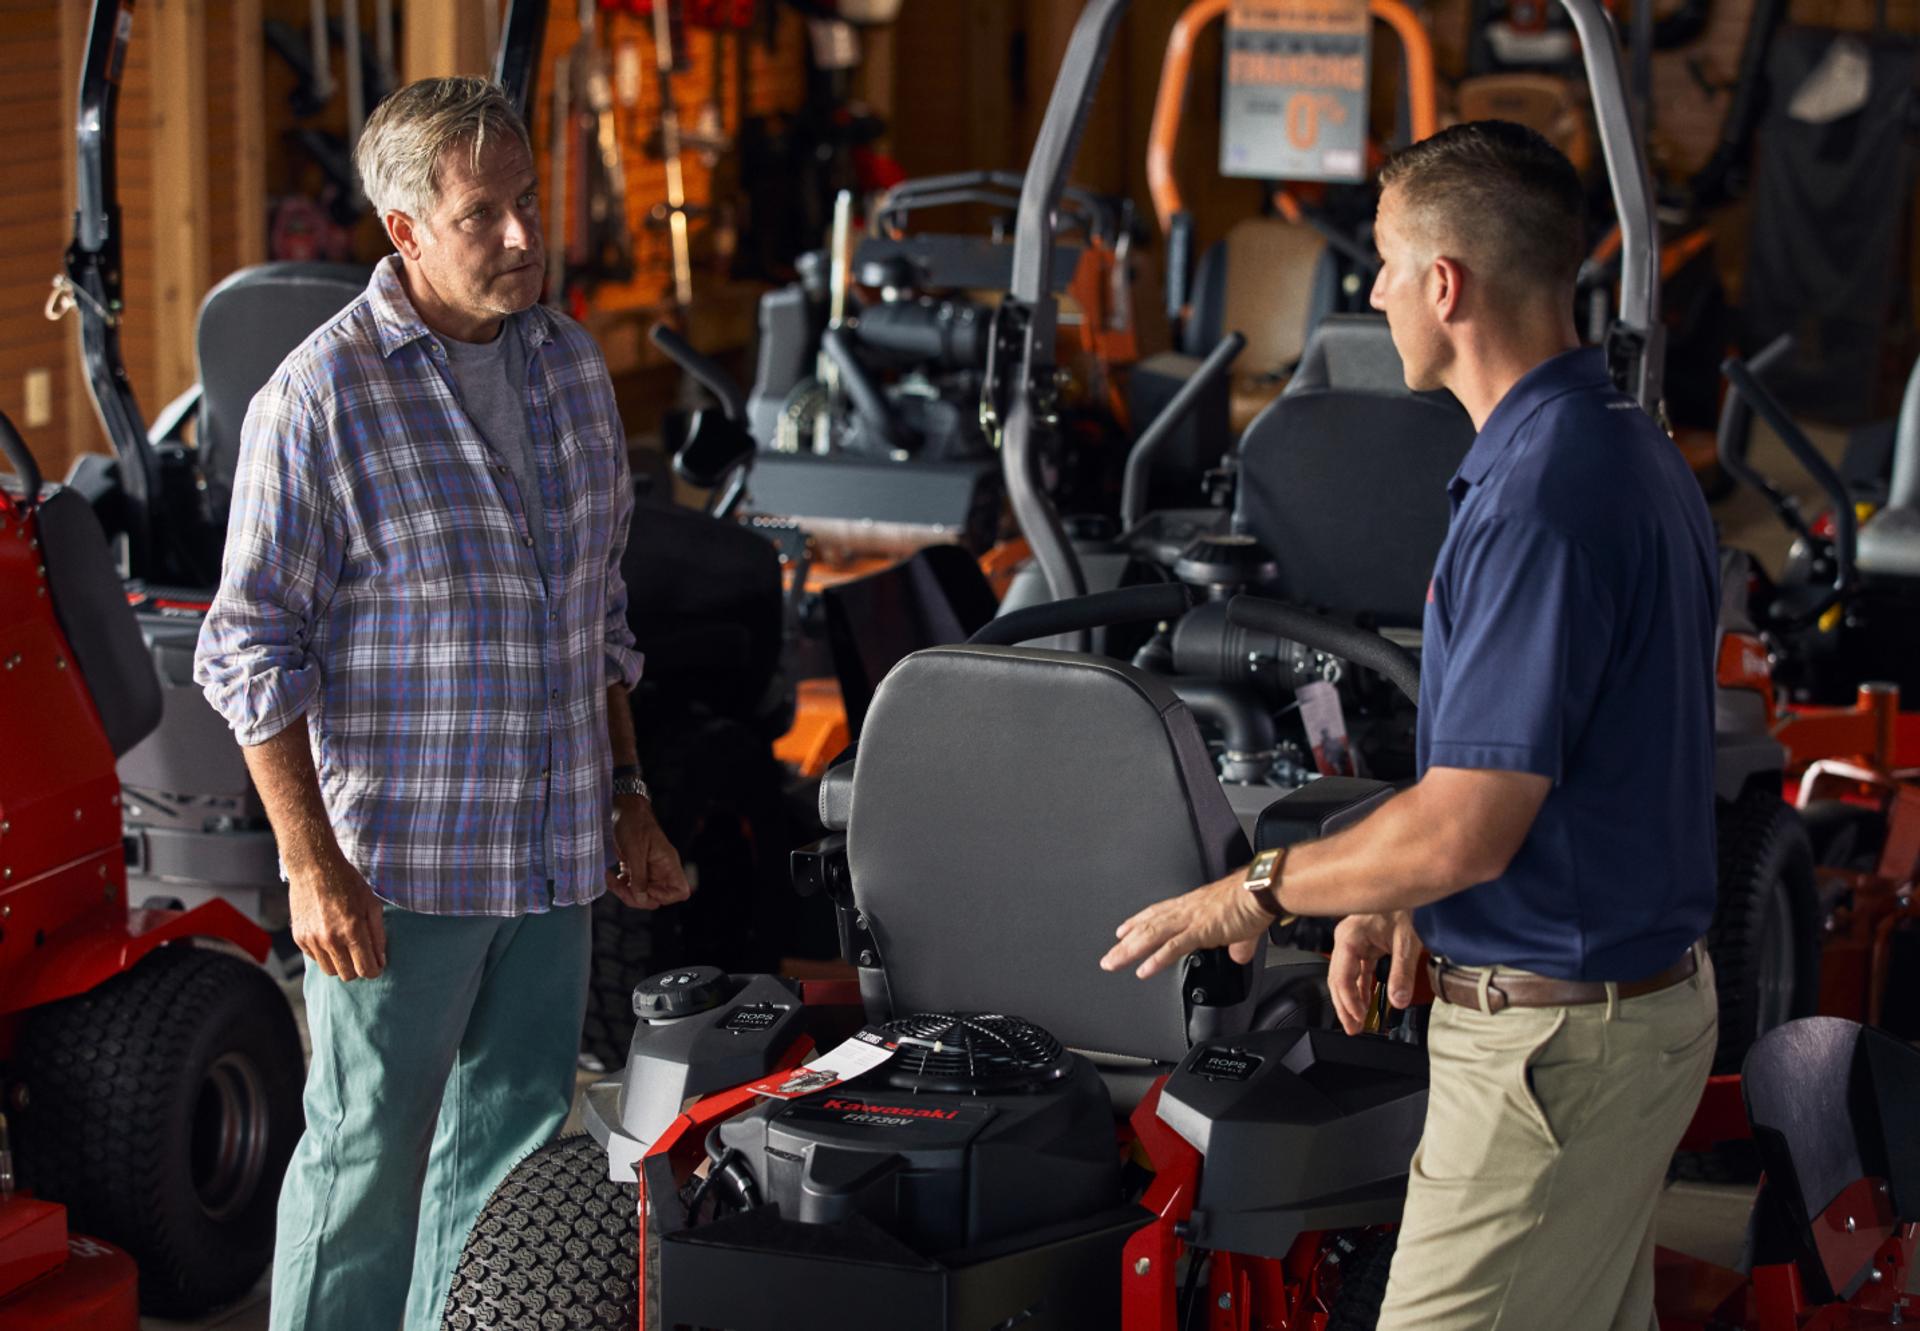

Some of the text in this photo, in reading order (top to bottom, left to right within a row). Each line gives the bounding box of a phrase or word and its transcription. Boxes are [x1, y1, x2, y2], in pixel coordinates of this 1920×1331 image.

[737, 1012, 774, 1021] ROPS
[1208, 1057, 1248, 1069] ROPS
[823, 1099, 959, 1120] Kawasaki
[842, 1113, 915, 1126] FR730V
